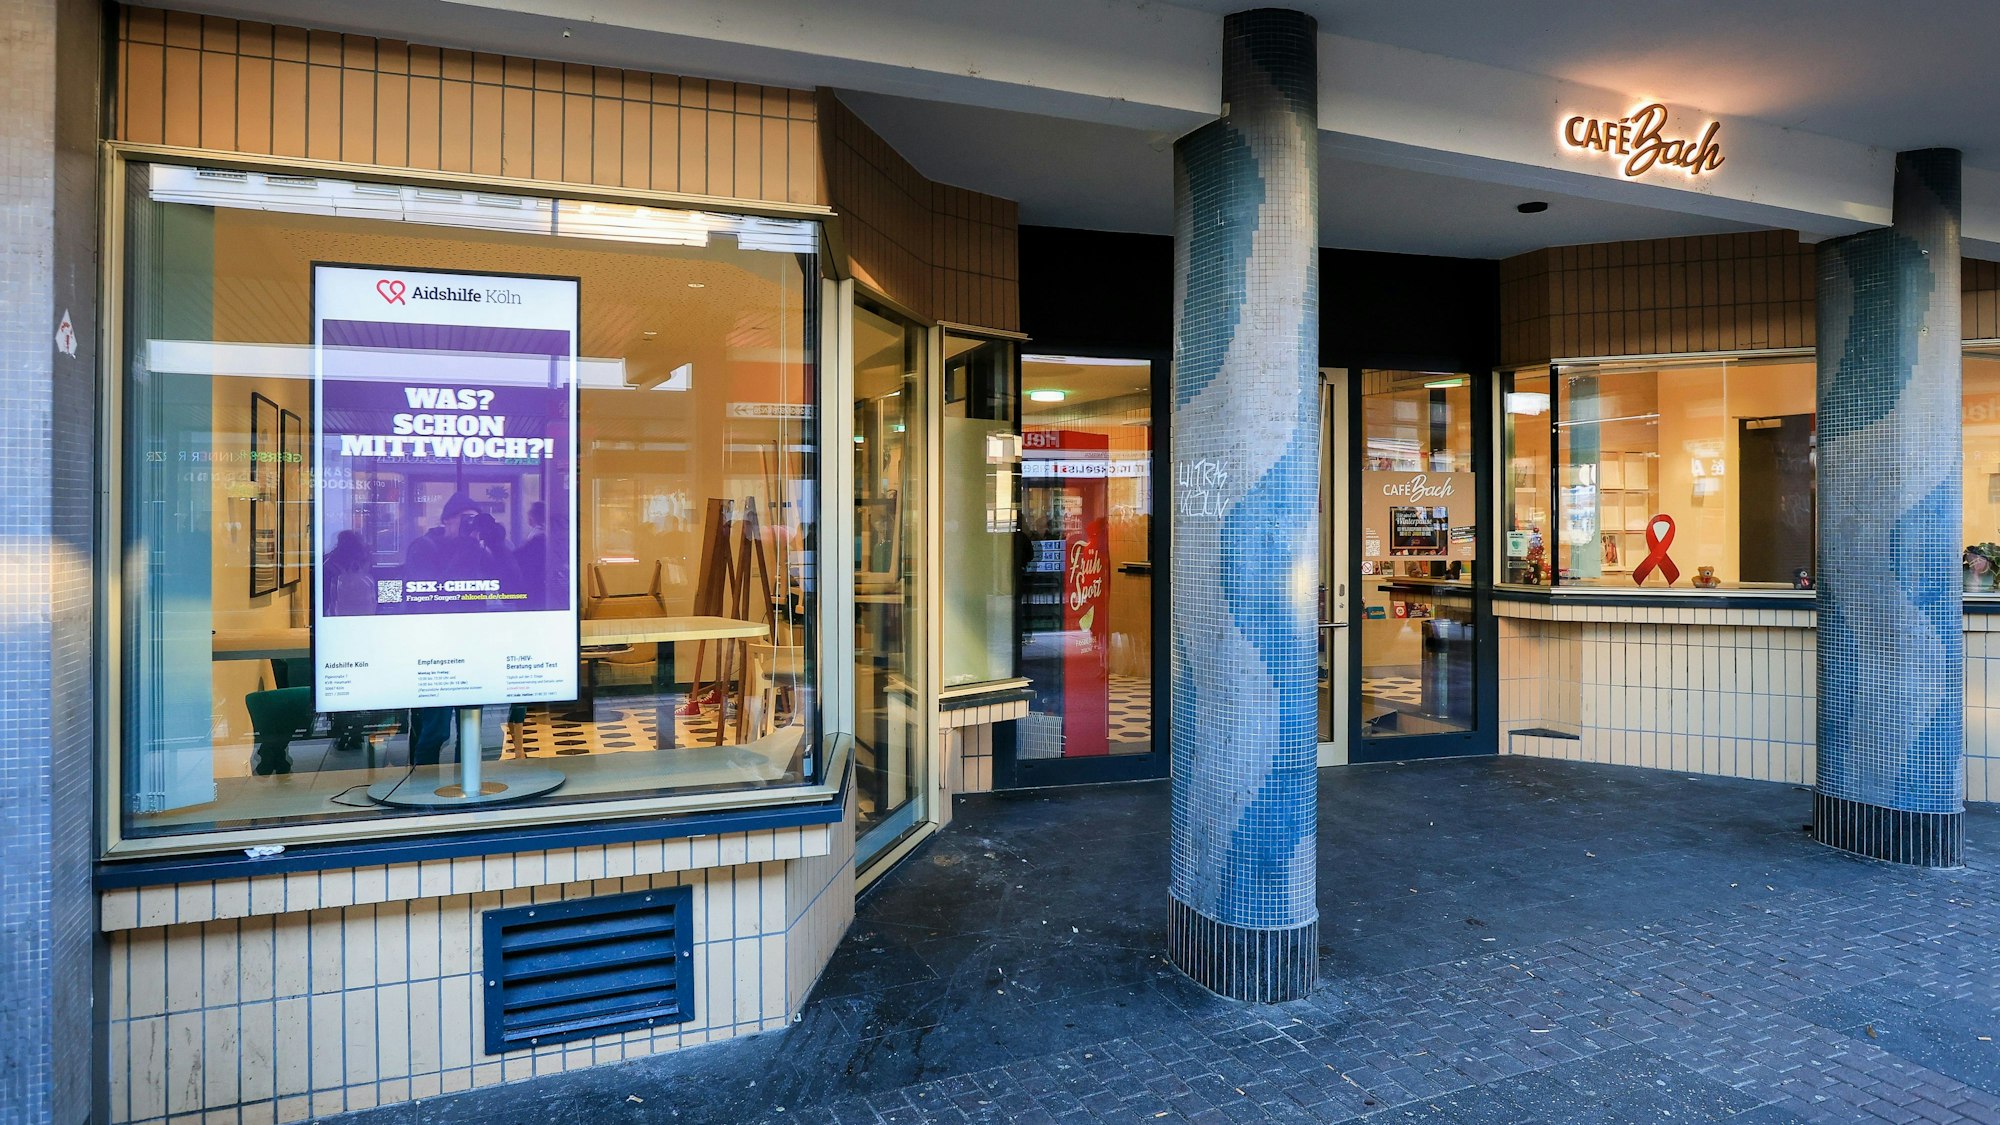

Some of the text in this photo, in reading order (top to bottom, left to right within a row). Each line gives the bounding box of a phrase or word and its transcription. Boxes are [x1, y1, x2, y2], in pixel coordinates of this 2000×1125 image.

[1565, 103, 1726, 177] CAFÉ Bach
[412, 286, 522, 305] Aidshilfe Köln
[404, 387, 495, 410] WAS?
[393, 413, 505, 436] SCHON
[340, 434, 554, 459] MITTWOCH?!
[1383, 474, 1455, 503] CAFÉ Bach
[1069, 540, 1103, 584] Früh
[405, 580, 500, 593] SEX+CHEMS
[405, 594, 434, 603] Fragen?
[433, 593, 461, 602] Sorgen?
[1069, 571, 1103, 611] Sport
[417, 658, 465, 666] Empfangszeiten
